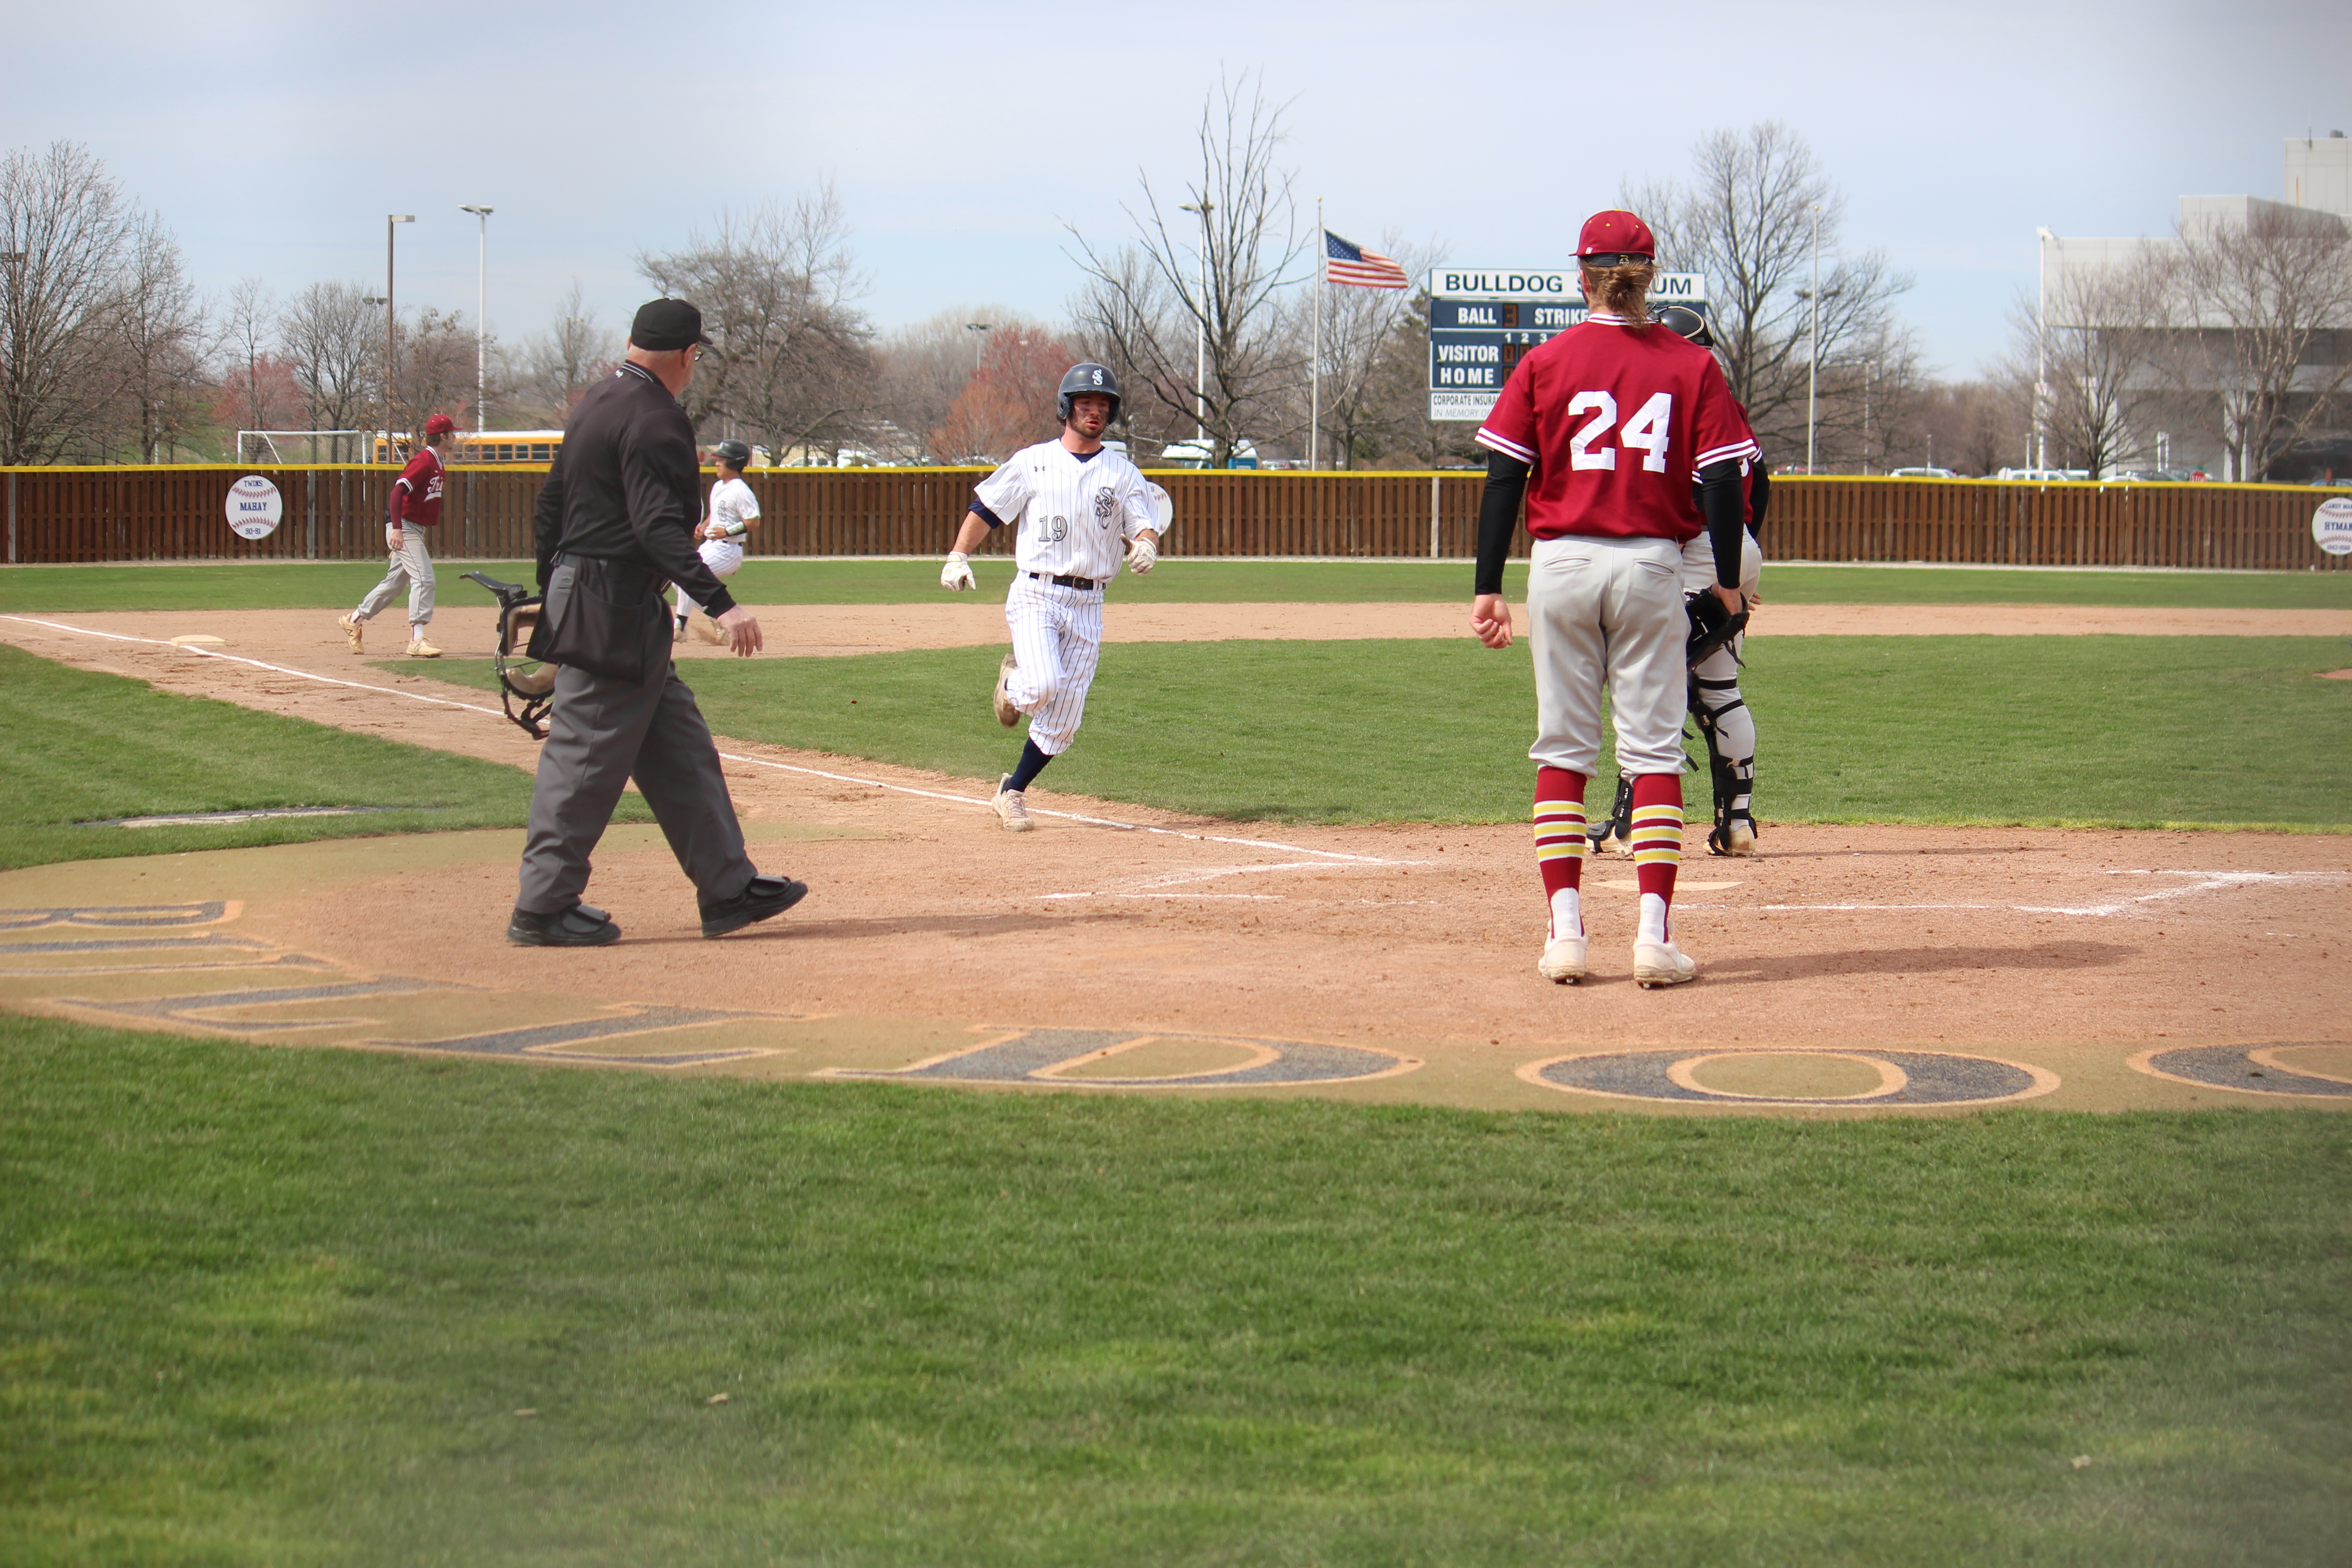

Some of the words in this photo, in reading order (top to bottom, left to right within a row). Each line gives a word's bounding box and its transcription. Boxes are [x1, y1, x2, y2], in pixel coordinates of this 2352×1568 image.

[1446, 274, 1563, 292] BULLDOG
[1458, 307, 1497, 324] BALL
[1504, 304, 1516, 327] 3
[1504, 332, 1511, 343] 1
[1521, 333, 1529, 343] 2
[1540, 333, 1548, 343] 3
[1438, 344, 1499, 363] VISITOR
[1440, 367, 1494, 385] HOME
[1433, 395, 1471, 406] CORPORATE
[1434, 409, 1443, 417] IN
[1445, 409, 1479, 418] MEMORY
[1568, 390, 1672, 474] 24
[240, 502, 267, 510] MAHAY
[1038, 515, 1068, 542] 19
